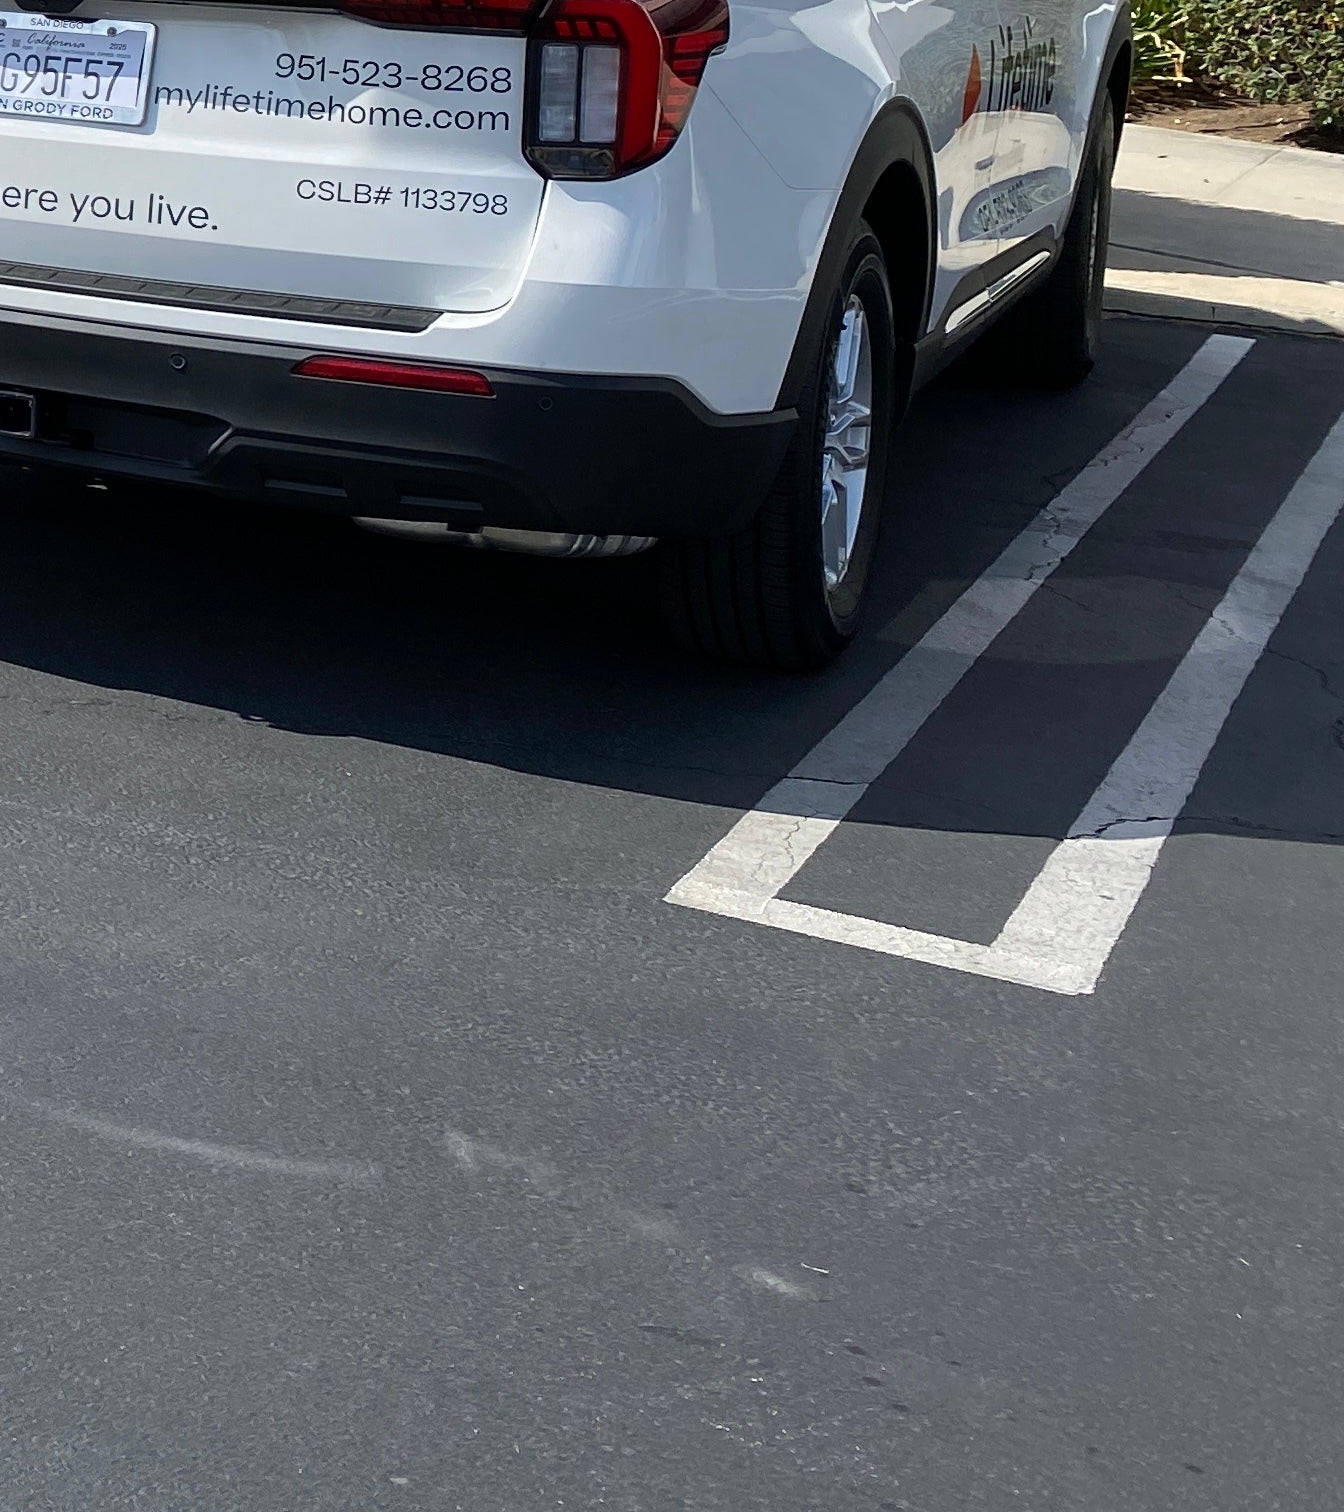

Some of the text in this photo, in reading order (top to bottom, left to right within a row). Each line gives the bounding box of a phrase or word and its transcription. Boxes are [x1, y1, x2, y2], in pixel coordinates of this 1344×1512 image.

[26, 32, 86, 51] California
[30, 17, 84, 30] SAN DIEGO
[275, 52, 513, 94] 951-523-8268
[12, 100, 68, 116] GRODY
[70, 105, 114, 120] FORD
[154, 83, 510, 131] mylifetimehome.com
[69, 192, 135, 223] you
[147, 193, 220, 231] live.
[296, 178, 508, 216] CSLB# 1133798
